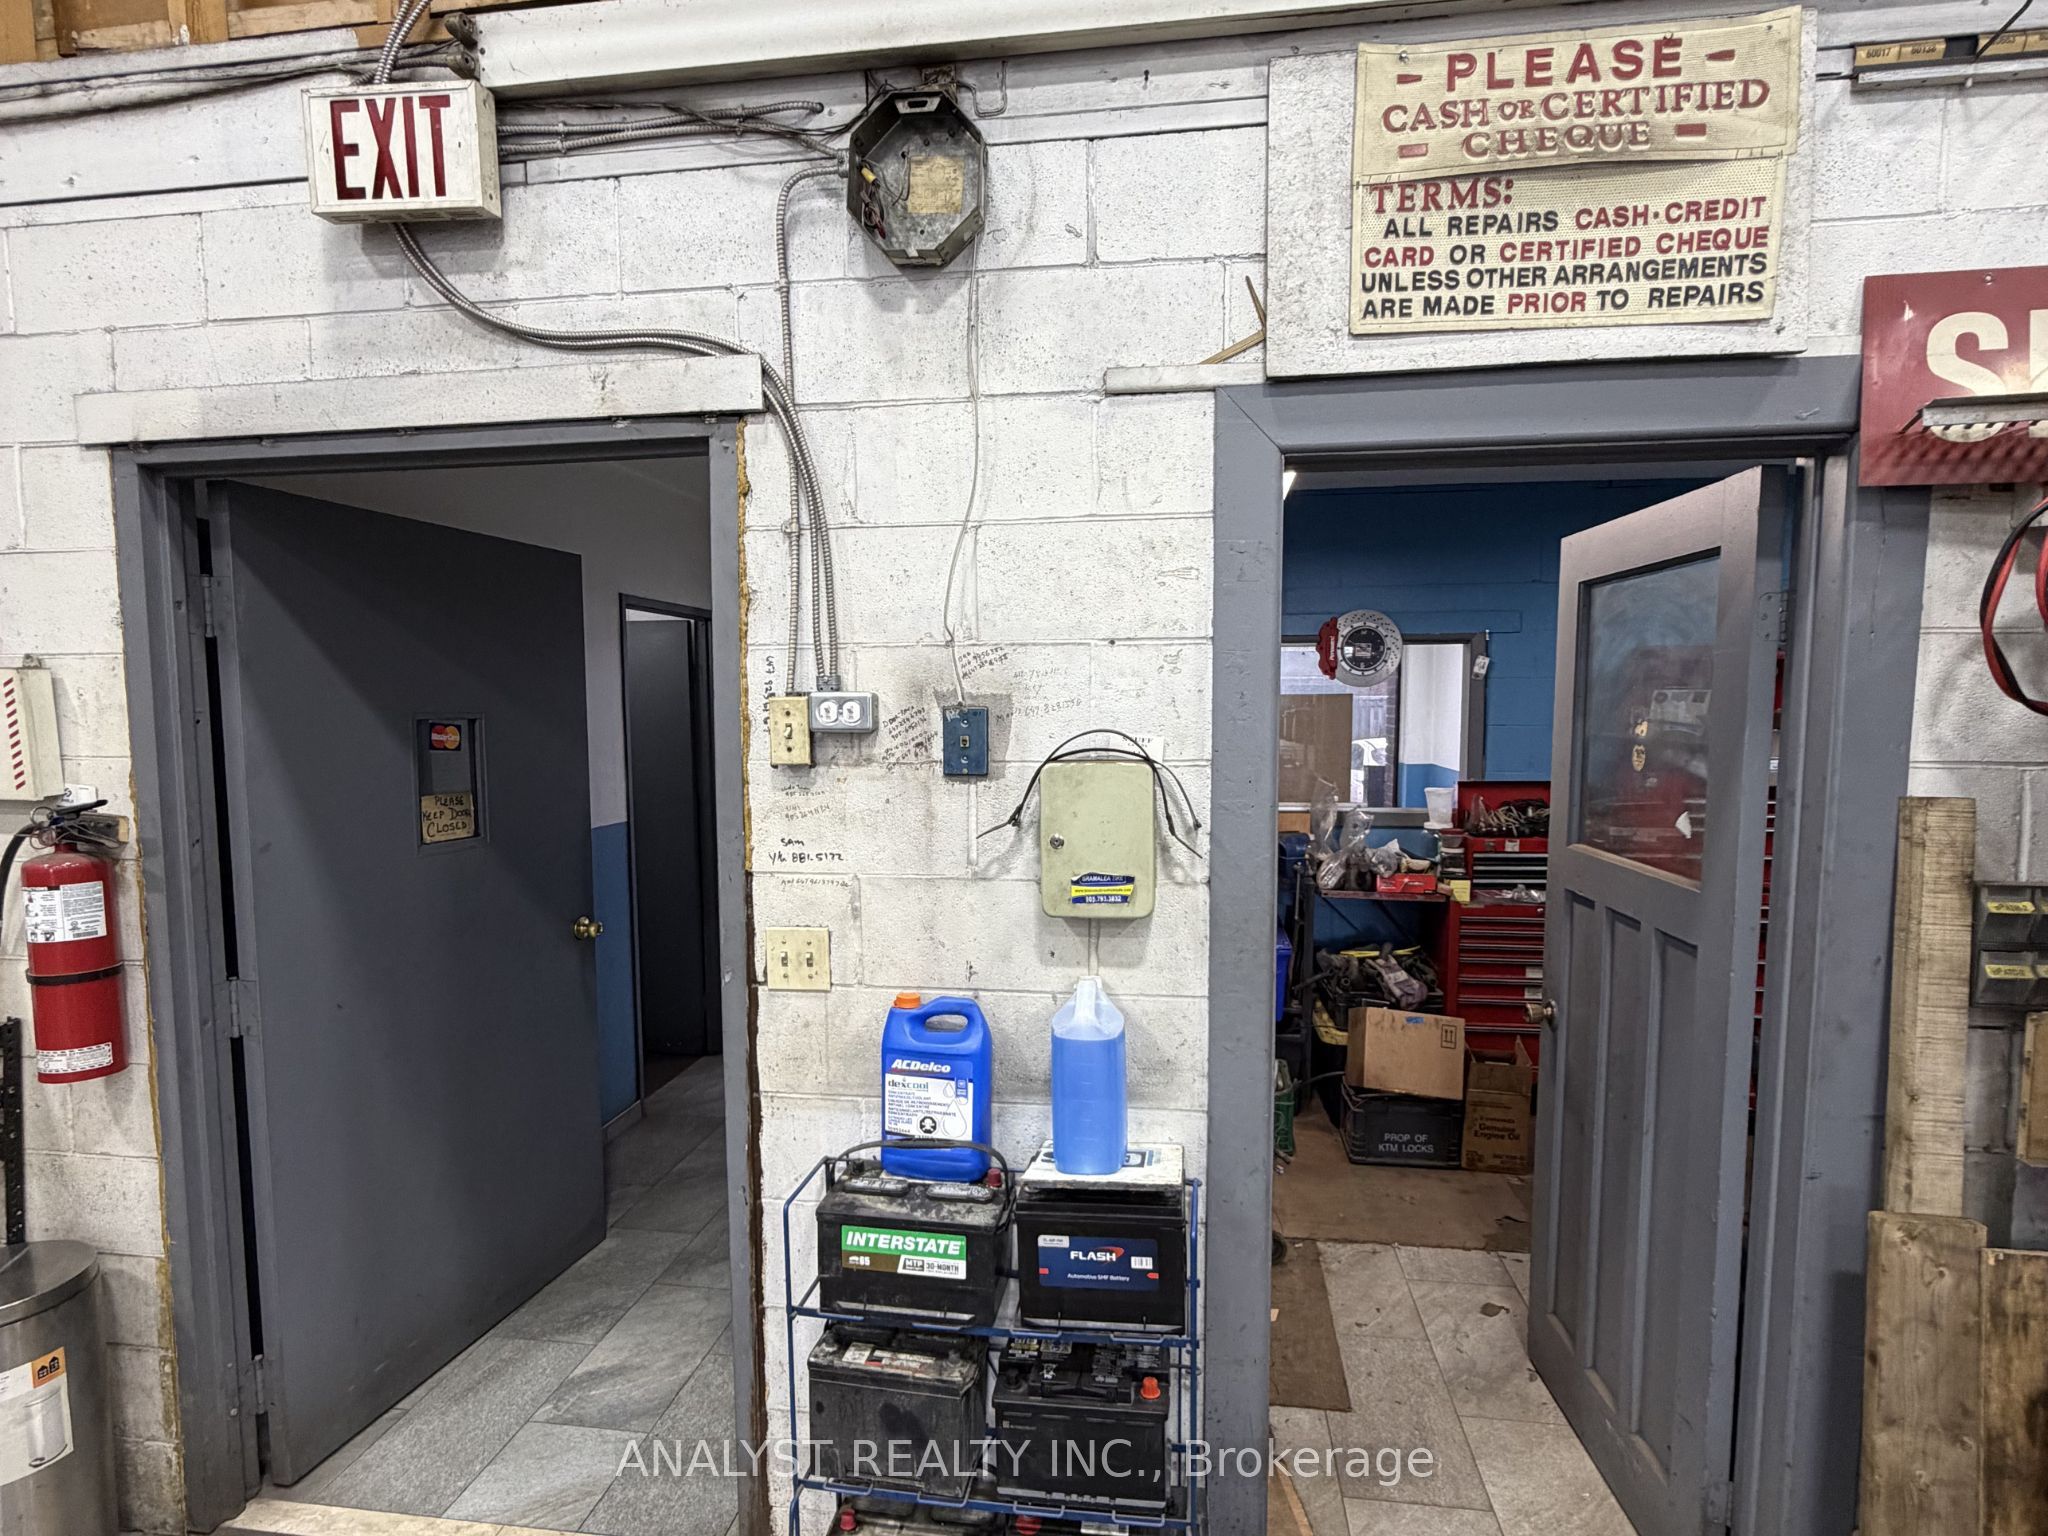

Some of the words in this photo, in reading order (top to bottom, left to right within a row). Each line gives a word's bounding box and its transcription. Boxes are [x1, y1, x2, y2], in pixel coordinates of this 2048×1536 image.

[1446, 37, 1683, 92] PLEASE
[1381, 97, 1490, 134] CASH
[1499, 100, 1536, 121] OR
[1540, 78, 1771, 121] CERTIFIED
[330, 94, 451, 200] EXIT
[1461, 121, 1651, 159] CHEQUE
[1370, 178, 1515, 214] TERMS:
[1383, 216, 1433, 238] ALL
[1447, 210, 1559, 236] REPAIRS
[1364, 245, 1435, 268] CARD
[1449, 243, 1485, 265] OR
[1500, 236, 1641, 262] CERTIFIED
[1656, 225, 1769, 254] CHEQUE
[1361, 268, 1460, 293] UNLESS
[1467, 265, 1547, 288] OTHER
[1553, 253, 1767, 286] ARRANGEMENTS
[1361, 299, 1413, 320] ARE
[1423, 295, 1495, 317] MADE
[1507, 291, 1587, 314] PRIOR
[1597, 288, 1629, 311] TO
[1648, 280, 1765, 309] REPAIRS
[891, 1059, 951, 1073] ACDelco
[1378, 1143, 1399, 1152] KTM
[1402, 1144, 1434, 1153] LOCKS
[1384, 1133, 1411, 1142] PROP
[1415, 1134, 1428, 1143] OF
[846, 1231, 961, 1255] INTERSTATE
[1070, 1251, 1117, 1262] FLASH
